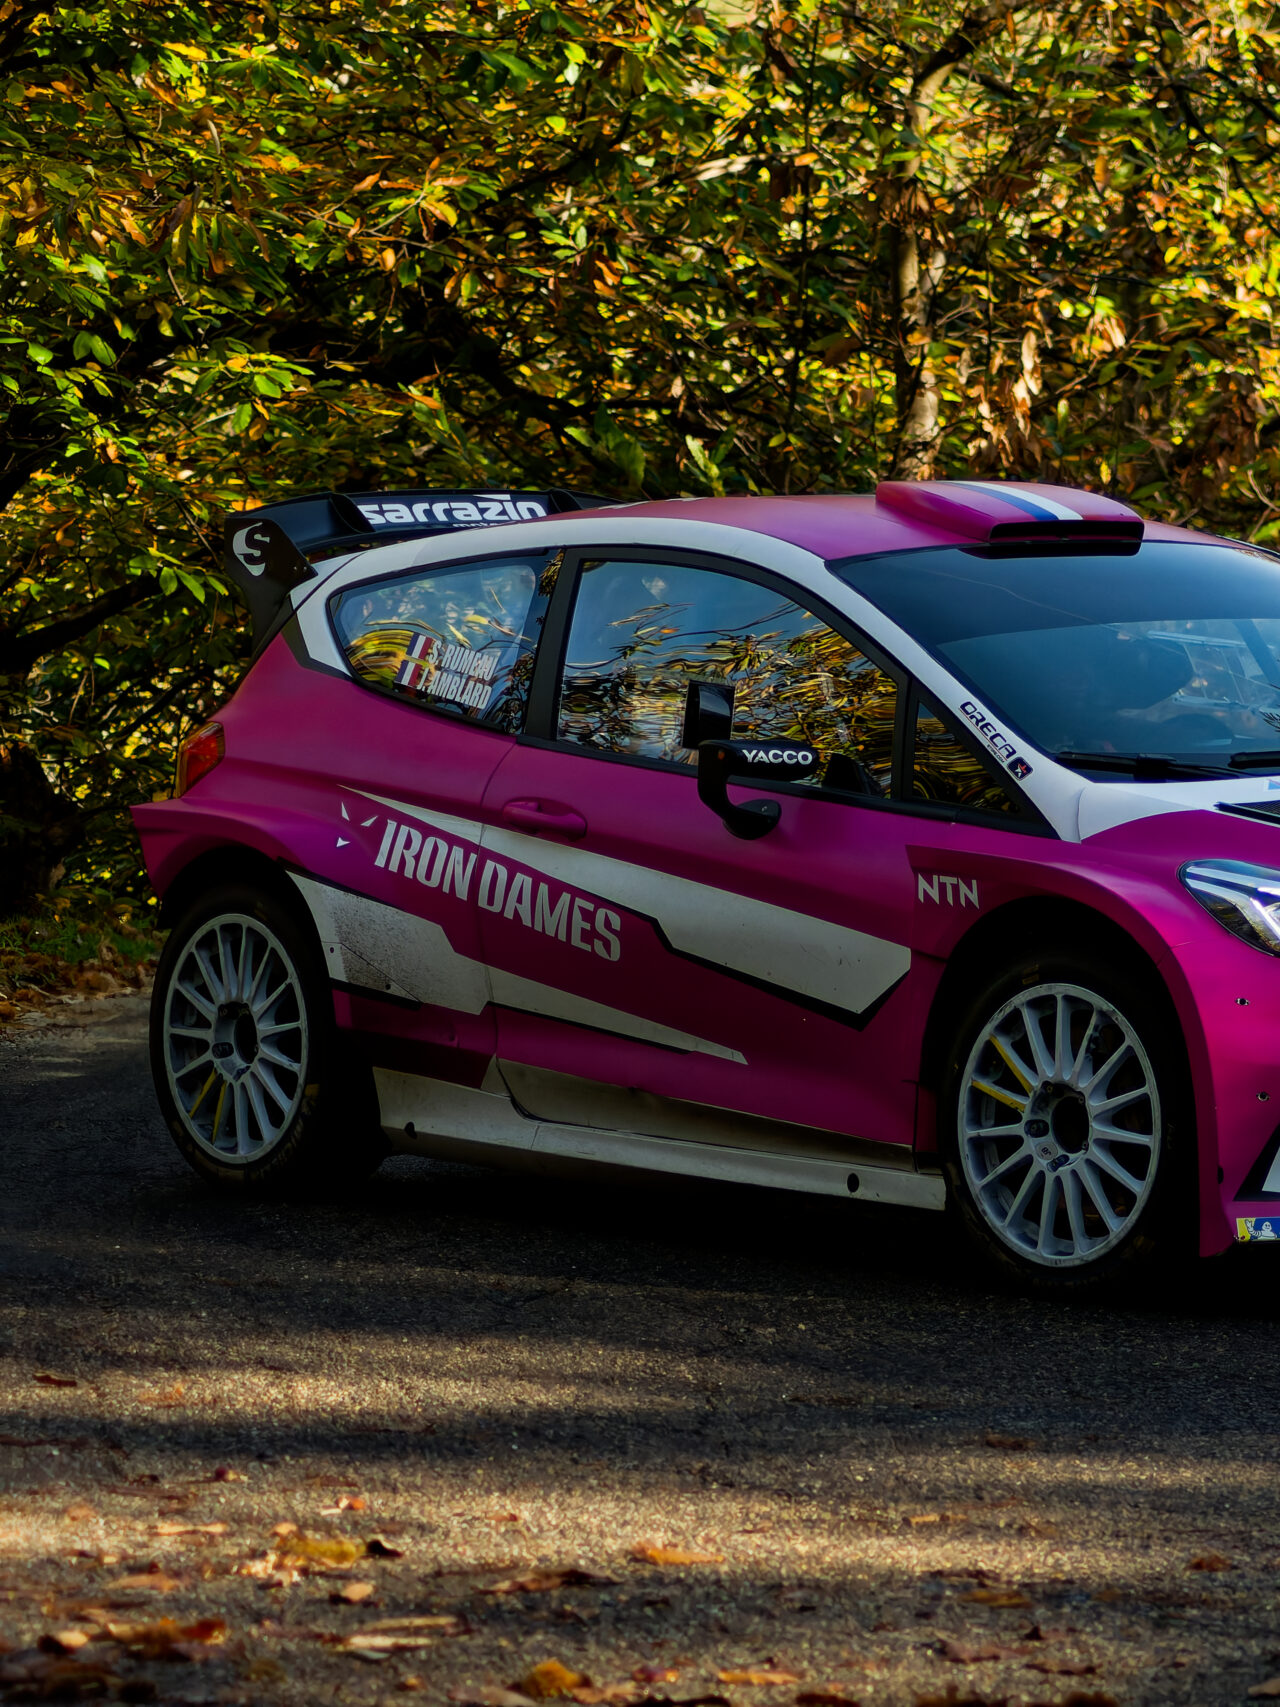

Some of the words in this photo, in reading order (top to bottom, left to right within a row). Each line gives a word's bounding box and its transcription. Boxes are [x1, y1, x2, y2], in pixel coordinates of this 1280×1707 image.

[356, 494, 549, 525] sarrazin
[428, 639, 442, 666] S.
[441, 643, 502, 681] RUMEAU
[416, 667, 430, 692] J.
[427, 670, 493, 710] AMBLARD
[959, 700, 1017, 759] ORECA
[741, 748, 813, 765] YACCO
[373, 818, 478, 902] IRON
[477, 858, 622, 962] DAMES
[917, 872, 980, 910] NTN
